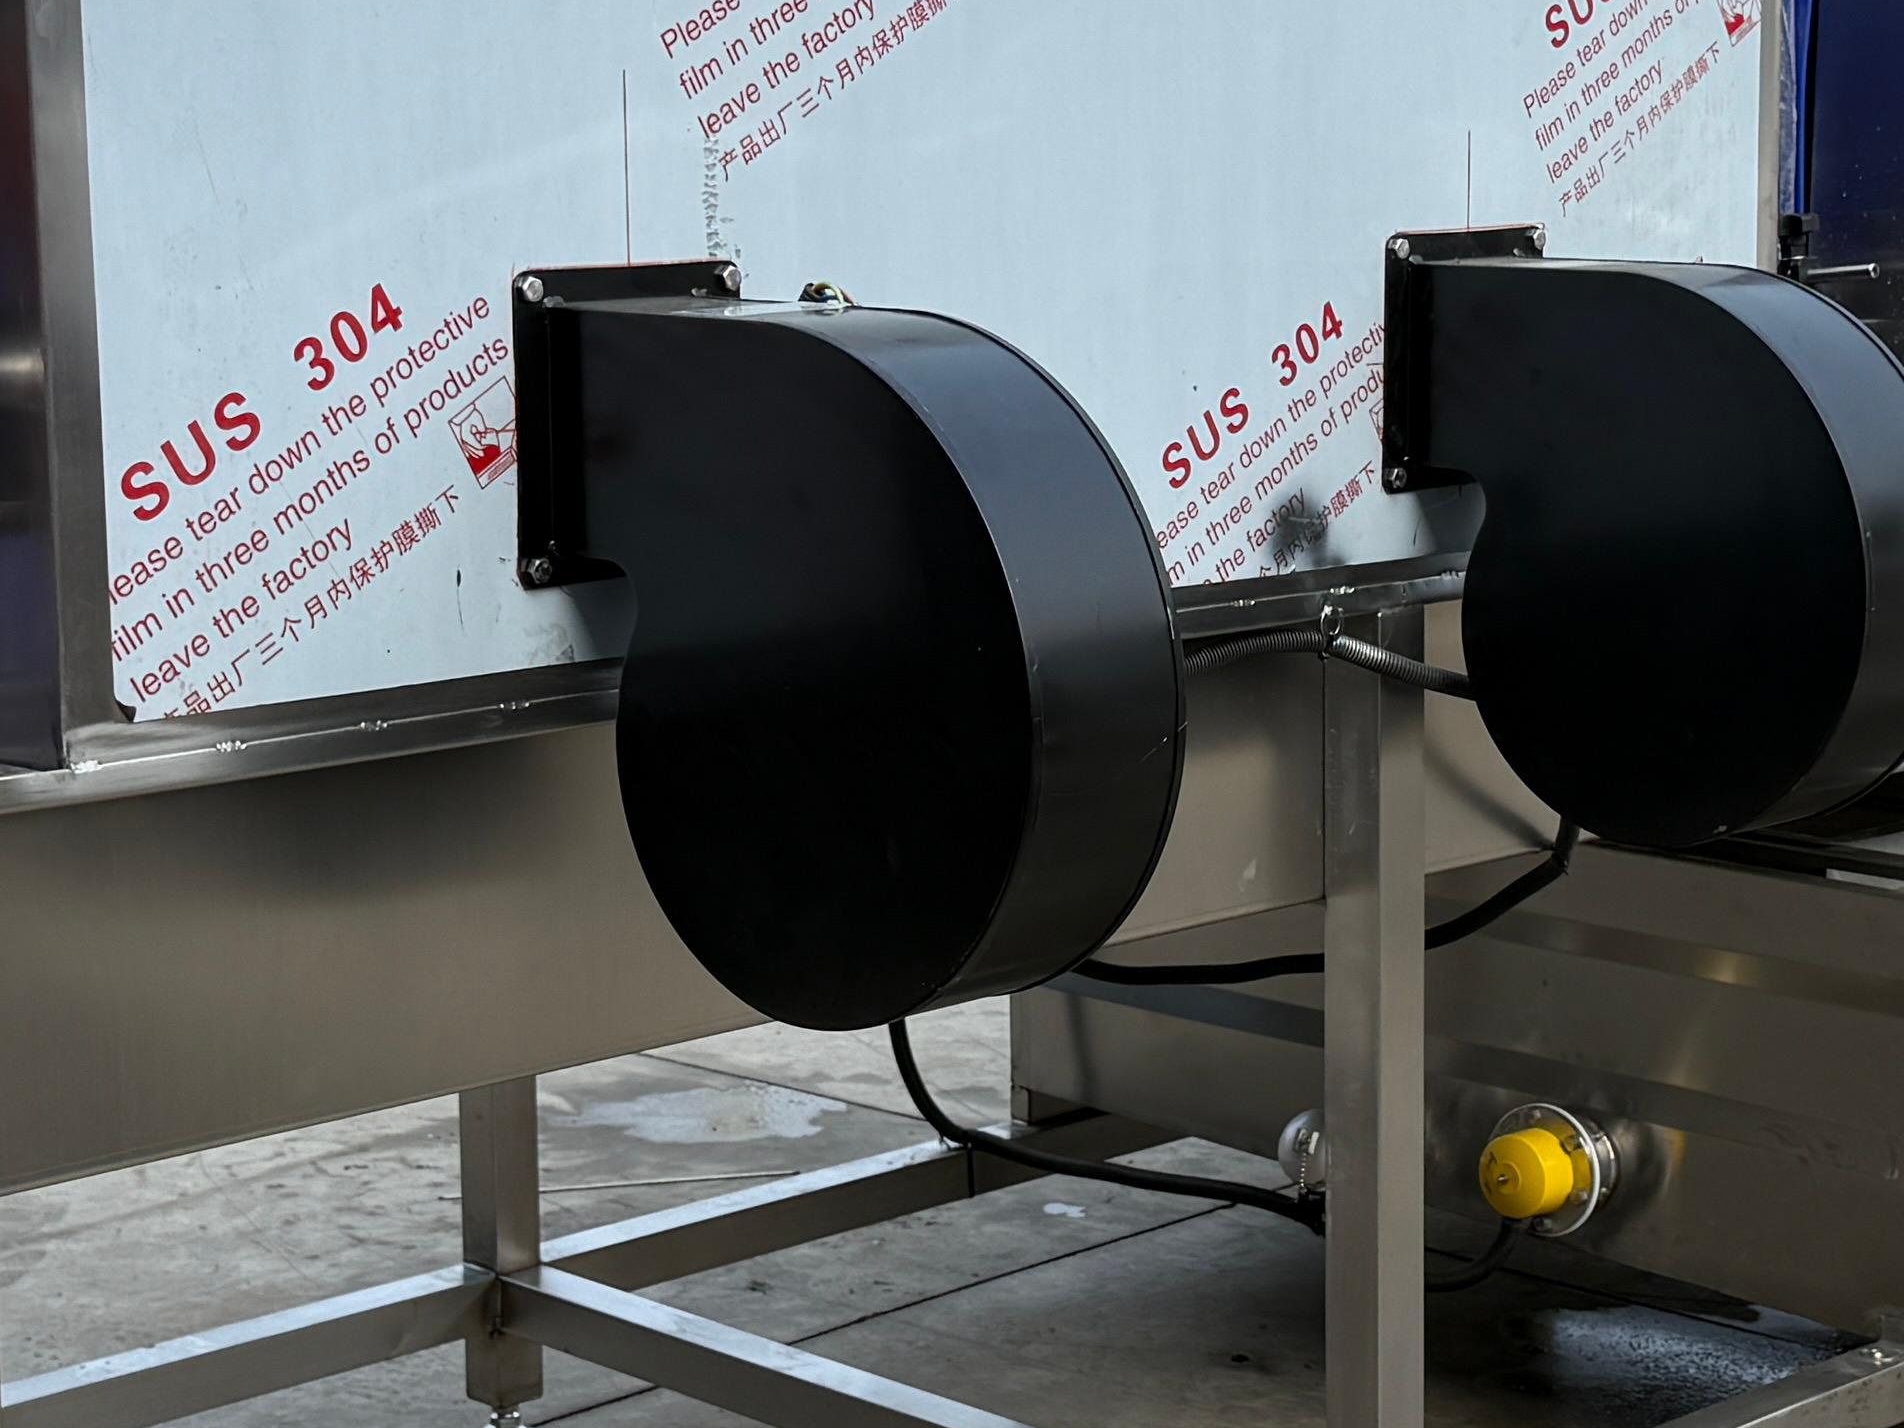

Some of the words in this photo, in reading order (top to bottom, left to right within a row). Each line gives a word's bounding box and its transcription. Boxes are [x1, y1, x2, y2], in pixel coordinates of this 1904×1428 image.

[680, 58, 723, 99] film
[723, 39, 748, 65] in
[698, 83, 760, 139] leave
[763, 53, 800, 89] the
[1524, 62, 1575, 118] Please
[1577, 29, 1605, 66] tear
[1536, 117, 1564, 150] film
[1564, 101, 1580, 123] in
[1582, 63, 1619, 106] three
[1622, 10, 1672, 68] months
[1547, 137, 1588, 183] leave
[1590, 111, 1614, 141] the
[1615, 60, 1661, 116] factory
[121, 393, 260, 521] SUS
[294, 284, 402, 390] 304
[186, 489, 241, 541] tear
[249, 431, 320, 494] down
[322, 395, 366, 436] the
[370, 298, 489, 407] protective
[1163, 388, 1248, 488] SUS
[1272, 302, 1342, 386] 304
[1200, 462, 1235, 504] tear
[1240, 418, 1286, 468] down
[1288, 390, 1316, 422] the
[112, 612, 162, 661] film
[162, 589, 194, 618] in
[196, 530, 269, 592] three
[273, 450, 370, 535] months
[375, 417, 399, 454] of
[404, 339, 508, 438] products
[1185, 542, 1205, 566] in
[1206, 496, 1252, 545] three
[1255, 433, 1317, 500] months
[1321, 407, 1337, 436] of
[1216, 549, 1245, 580] the
[1247, 488, 1310, 552] factory
[130, 635, 210, 702] leave
[213, 596, 259, 638] the
[262, 520, 351, 600] factory
